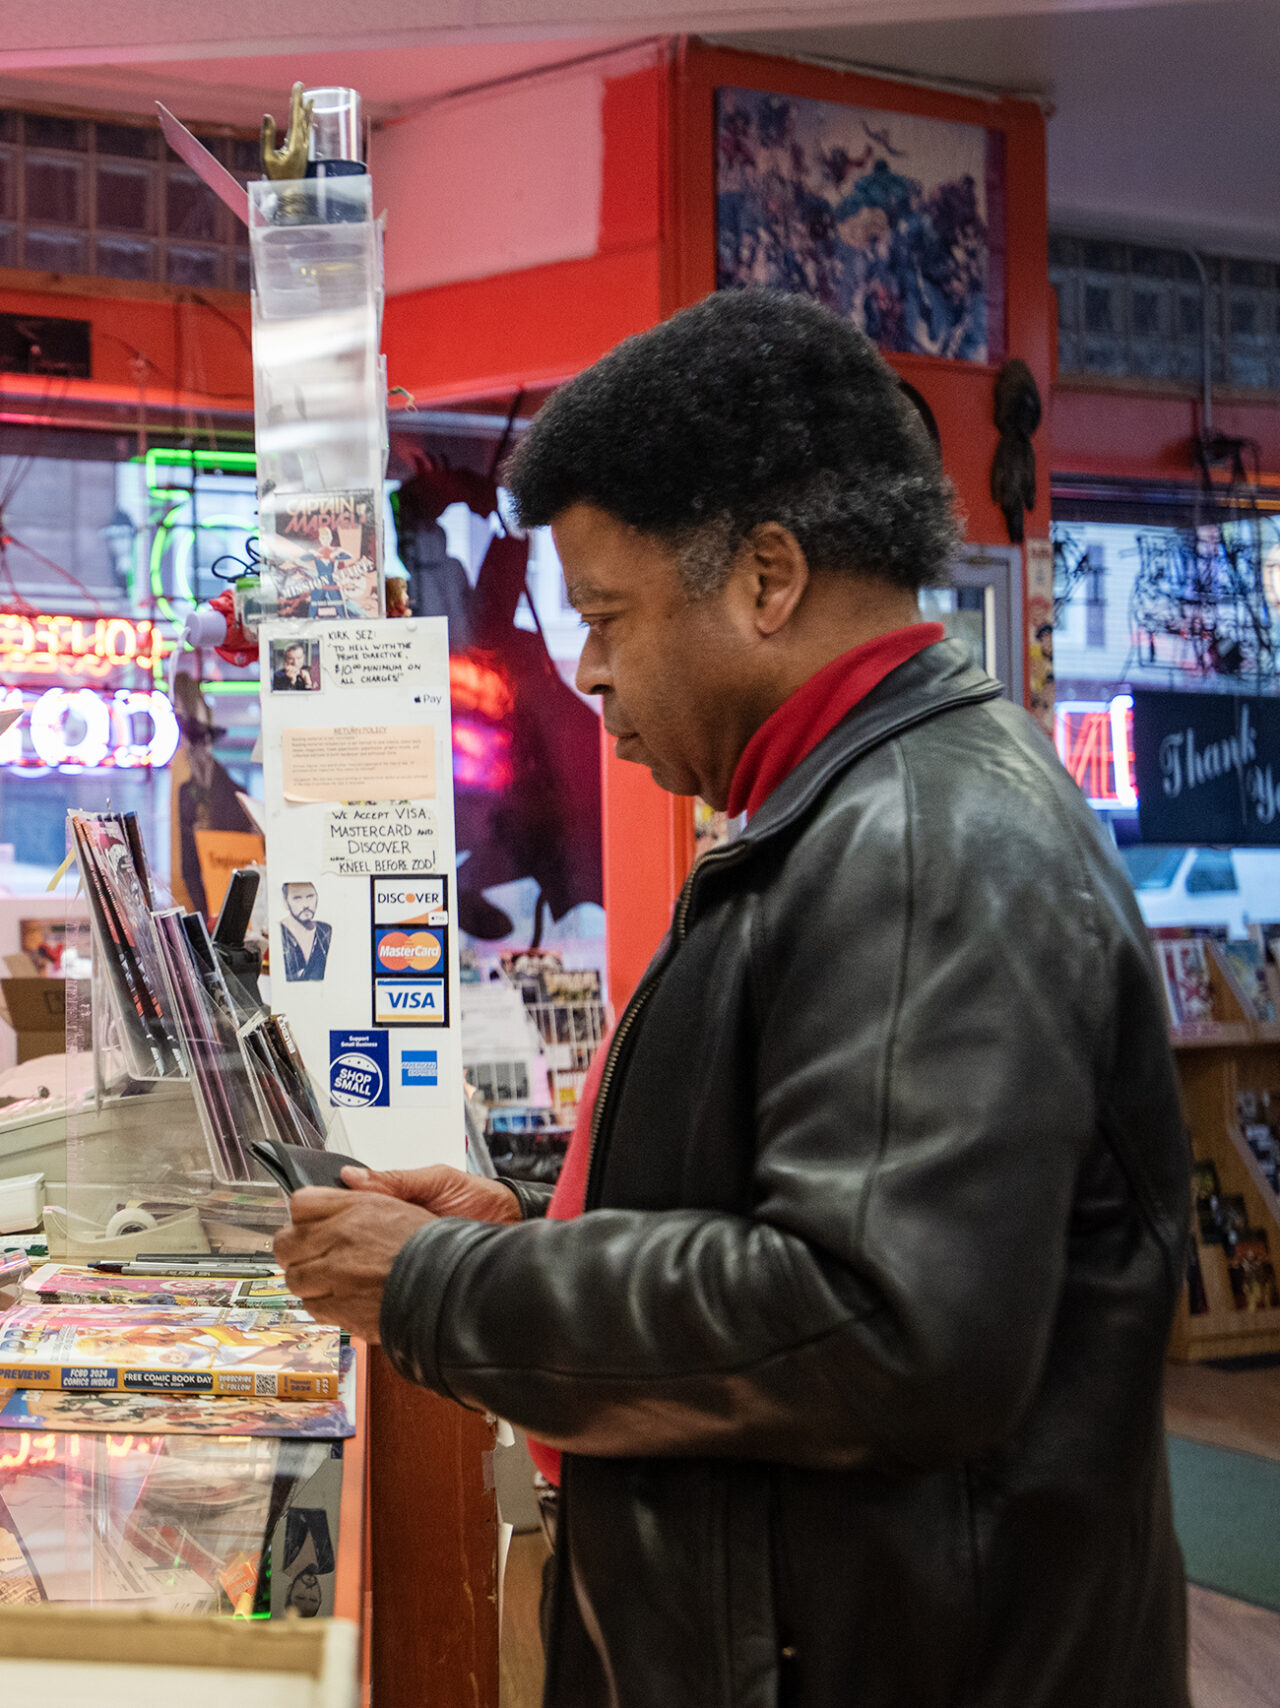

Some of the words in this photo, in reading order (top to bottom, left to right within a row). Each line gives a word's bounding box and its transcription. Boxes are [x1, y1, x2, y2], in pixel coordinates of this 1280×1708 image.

[285, 495, 355, 516] CAPTAIN
[328, 631, 349, 640] KIRK
[362, 664, 402, 672] MINIMUM
[423, 694, 442, 705] Pay
[1160, 703, 1257, 798] Thank
[330, 824, 413, 838] MASTERCARD
[339, 861, 371, 873] KNEEL
[375, 860, 407, 872] BEFORE
[377, 892, 440, 904] DISCOVER
[380, 945, 440, 957] MasterCard
[386, 992, 435, 1008] VISA
[339, 1067, 372, 1085] SHOP
[334, 1077, 371, 1096] SMALL
[90, 1370, 108, 1378] 2024
[124, 1373, 143, 1382] FREE
[144, 1373, 171, 1382] COMIC
[172, 1373, 195, 1383] BOOK
[196, 1375, 213, 1384] DAY
[63, 1378, 90, 1387] COMICS
[91, 1378, 116, 1387] INSIDE!
[226, 1383, 252, 1391] FOLLOW
